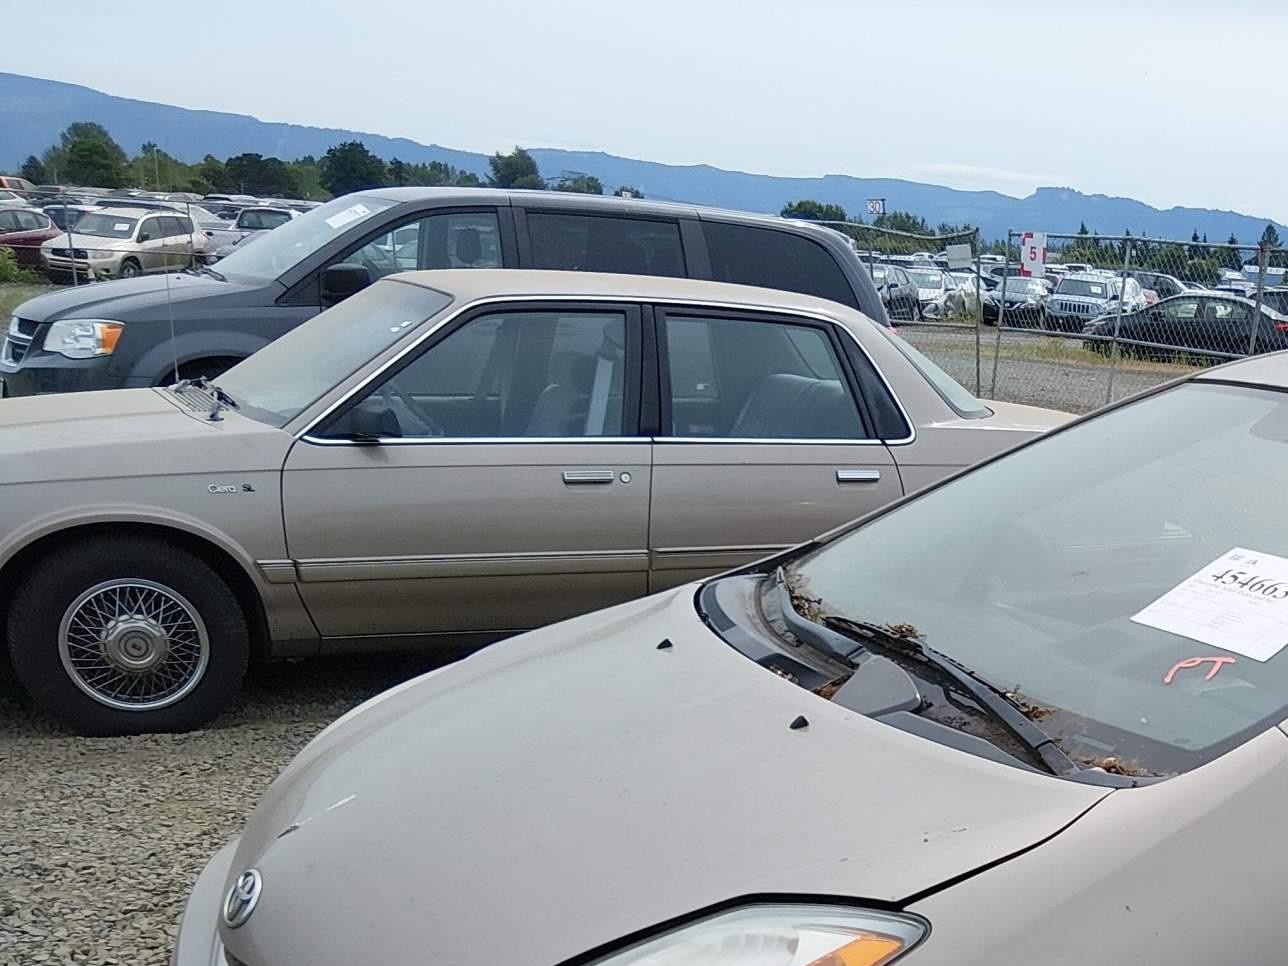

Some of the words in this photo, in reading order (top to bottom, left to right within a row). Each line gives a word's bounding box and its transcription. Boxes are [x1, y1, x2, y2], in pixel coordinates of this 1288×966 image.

[868, 202, 881, 213] 30
[1029, 246, 1037, 261] 5
[242, 483, 257, 493] SL
